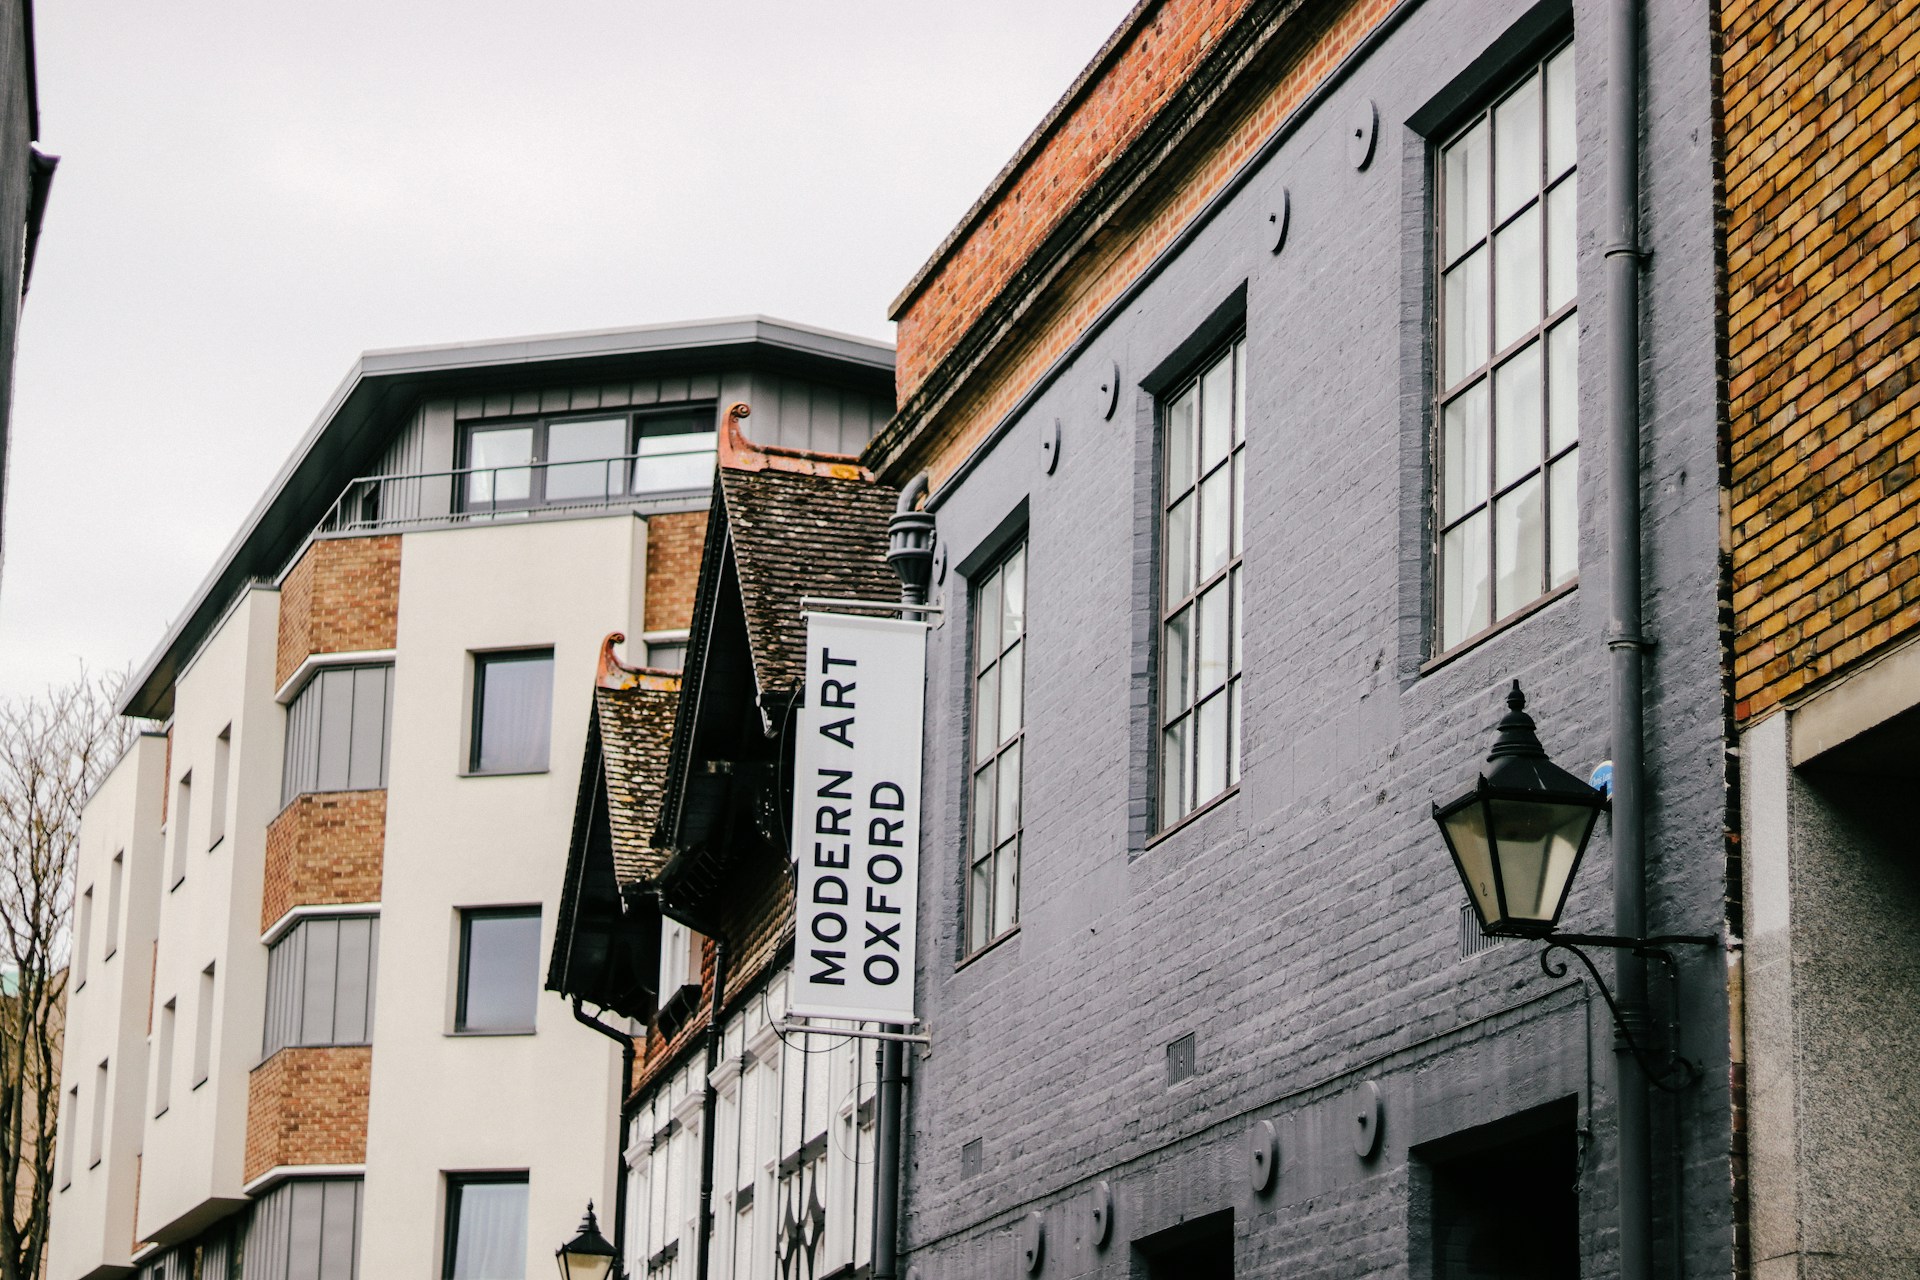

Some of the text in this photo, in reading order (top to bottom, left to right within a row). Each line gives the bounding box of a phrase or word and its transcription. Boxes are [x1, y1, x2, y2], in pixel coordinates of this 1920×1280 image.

[809, 647, 857, 986] MODERN ART
[863, 781, 905, 986] OXFORD
